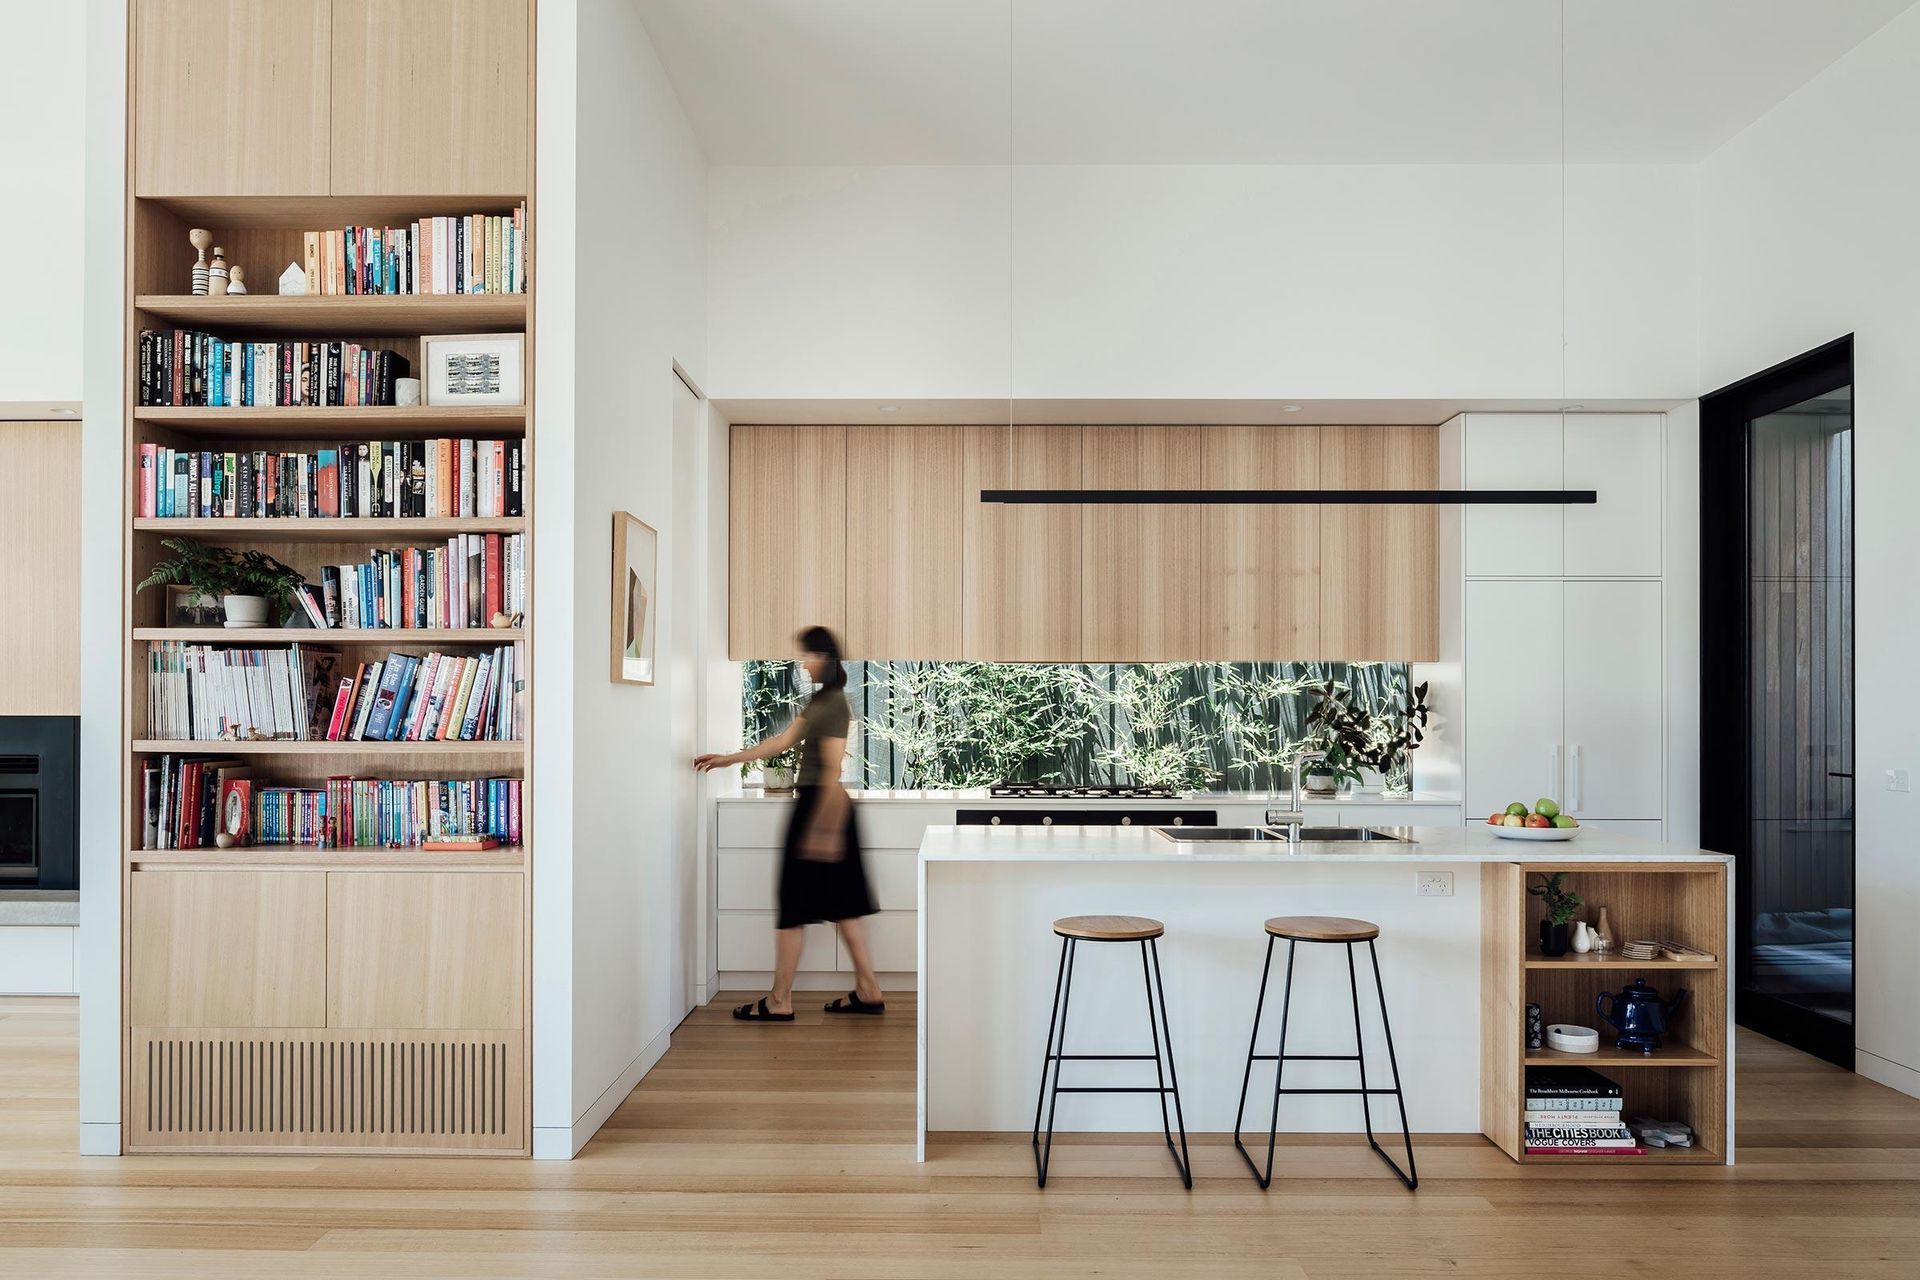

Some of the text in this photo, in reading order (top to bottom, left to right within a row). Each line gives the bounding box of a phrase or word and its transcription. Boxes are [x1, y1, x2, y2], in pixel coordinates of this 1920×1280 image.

[213, 470, 222, 495] Ellroy
[382, 658, 397, 687] Kitchen
[390, 674, 398, 686] the
[1531, 1129, 1620, 1138] THE CITIES BOOK
